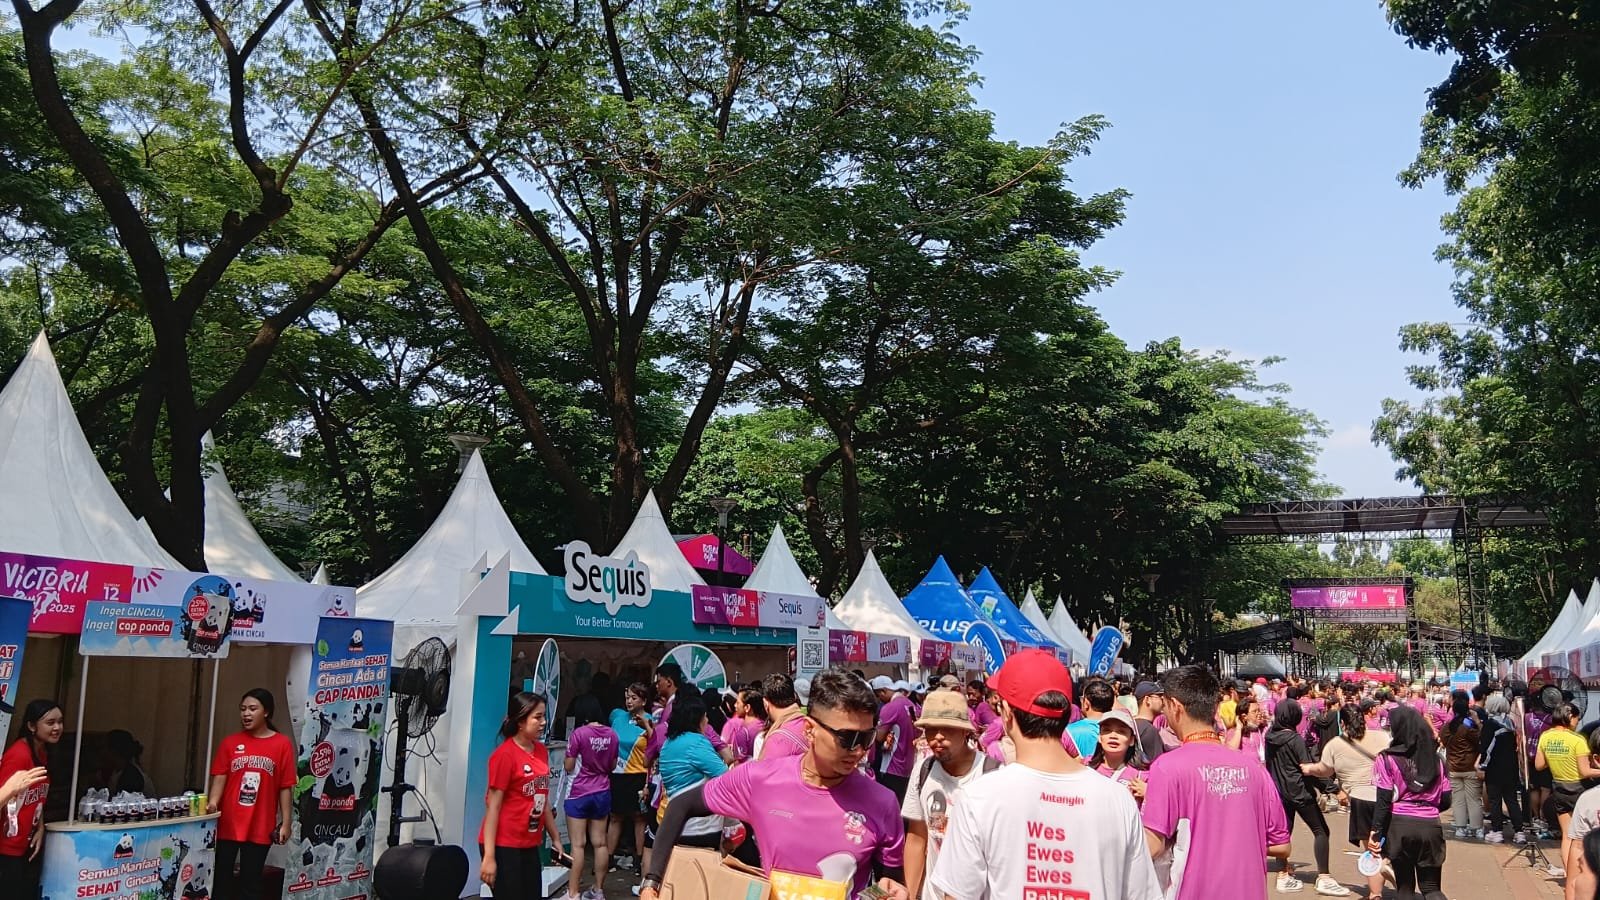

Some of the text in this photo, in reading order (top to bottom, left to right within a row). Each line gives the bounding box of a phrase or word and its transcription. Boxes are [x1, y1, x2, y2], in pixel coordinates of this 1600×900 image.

[571, 551, 647, 604] Sequis
[103, 586, 120, 601] 12
[48, 603, 76, 614] 2025
[99, 605, 165, 618] Inget CINCAU,
[778, 598, 803, 618] Sequis
[86, 619, 170, 634] Inget cap panda
[575, 615, 644, 630] Your Better Tomorrow
[364, 655, 388, 666] SEHAT
[318, 667, 388, 687] Cincau Ada di
[315, 688, 340, 705] CAP
[313, 747, 333, 761] 25%
[330, 796, 354, 809] panda
[1039, 792, 1085, 806] Antangin
[313, 823, 351, 836] CINCAU
[1027, 820, 1066, 841] Wes
[1027, 843, 1074, 864] Ewes
[79, 857, 161, 881] Semua Manfaat
[1026, 865, 1073, 885] Ewes
[77, 873, 160, 898] SEHAT Cincau
